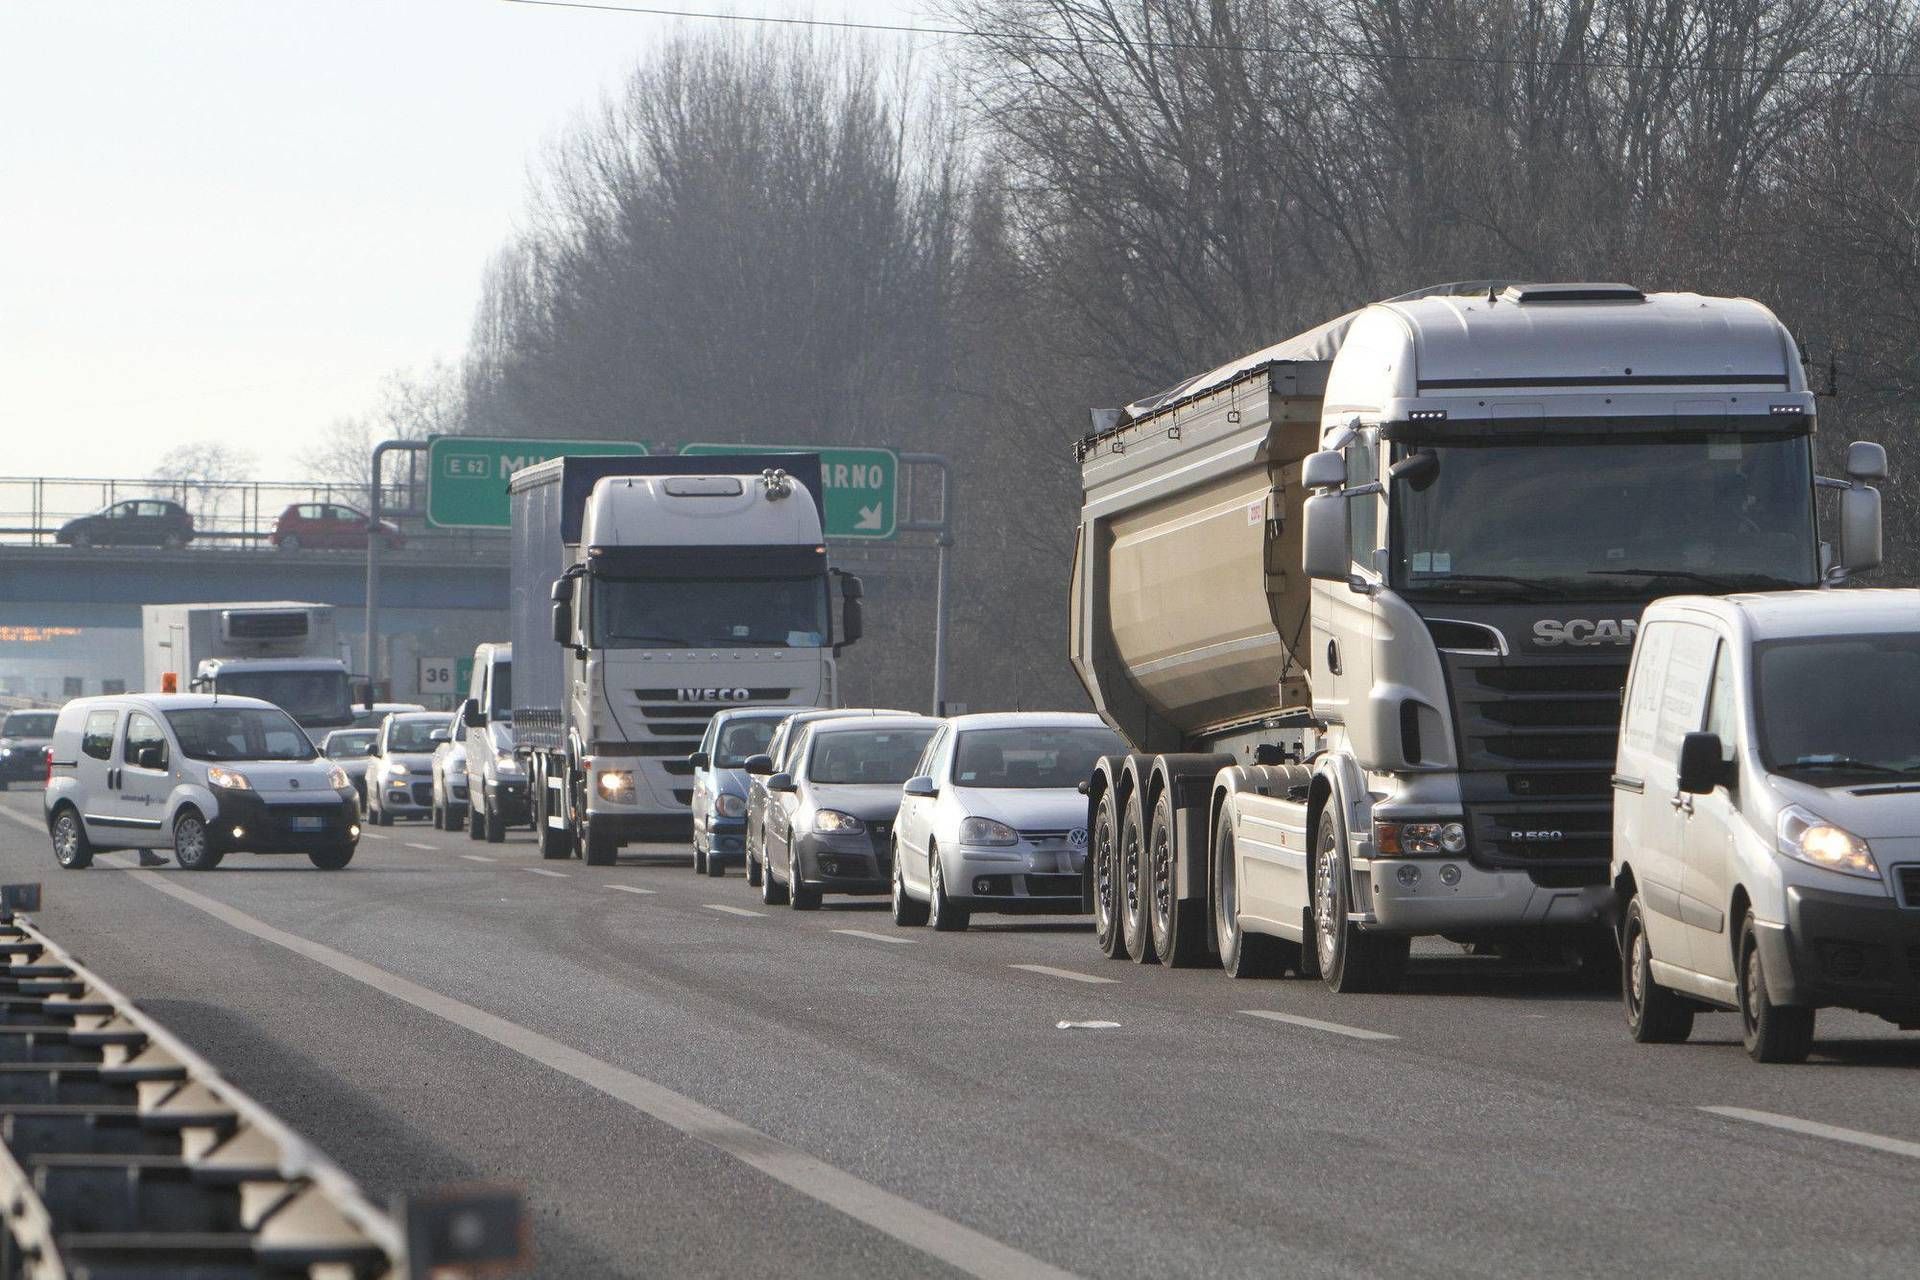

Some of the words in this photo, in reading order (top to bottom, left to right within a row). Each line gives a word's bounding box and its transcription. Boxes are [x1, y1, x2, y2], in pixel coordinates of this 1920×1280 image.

[451, 459, 461, 473] E
[467, 459, 484, 474] 62
[426, 668, 449, 683] 36
[677, 687, 749, 701] IVECO
